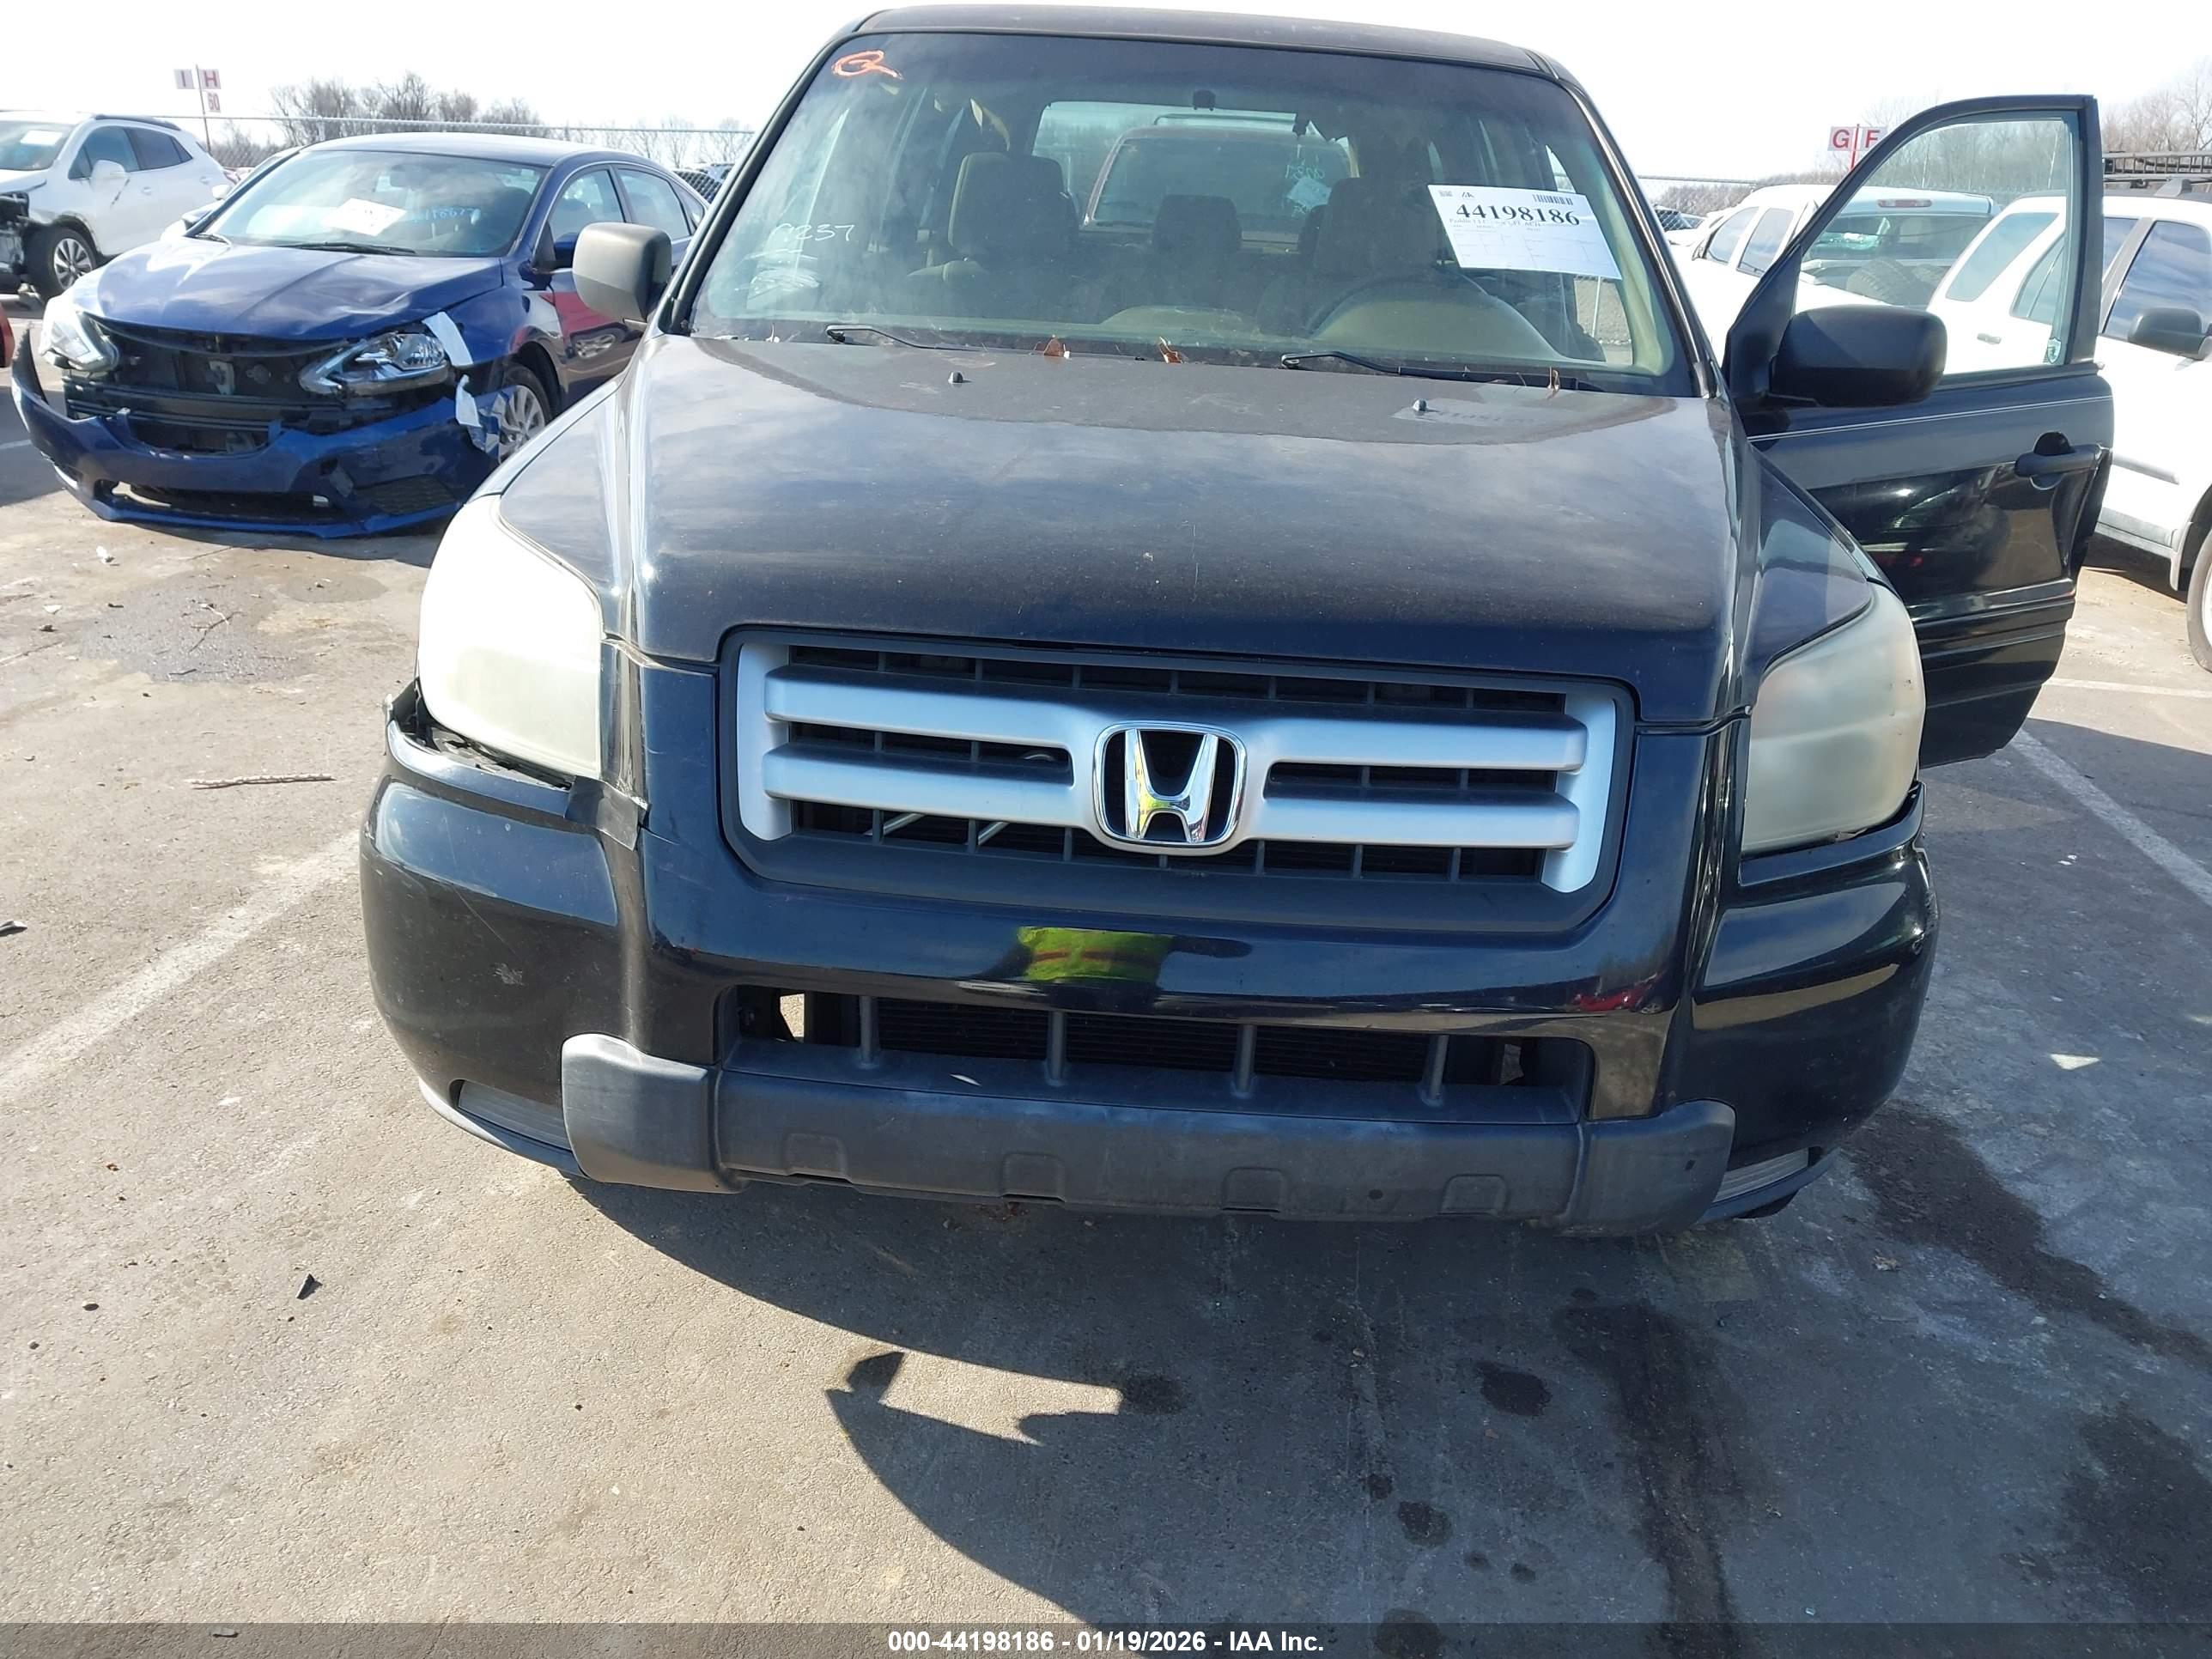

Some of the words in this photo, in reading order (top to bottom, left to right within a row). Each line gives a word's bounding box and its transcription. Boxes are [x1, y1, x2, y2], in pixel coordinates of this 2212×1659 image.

[203, 70, 218, 88] H
[1832, 129, 1850, 149] G
[1865, 129, 1881, 149] F
[1455, 203, 1580, 226] 44198186
